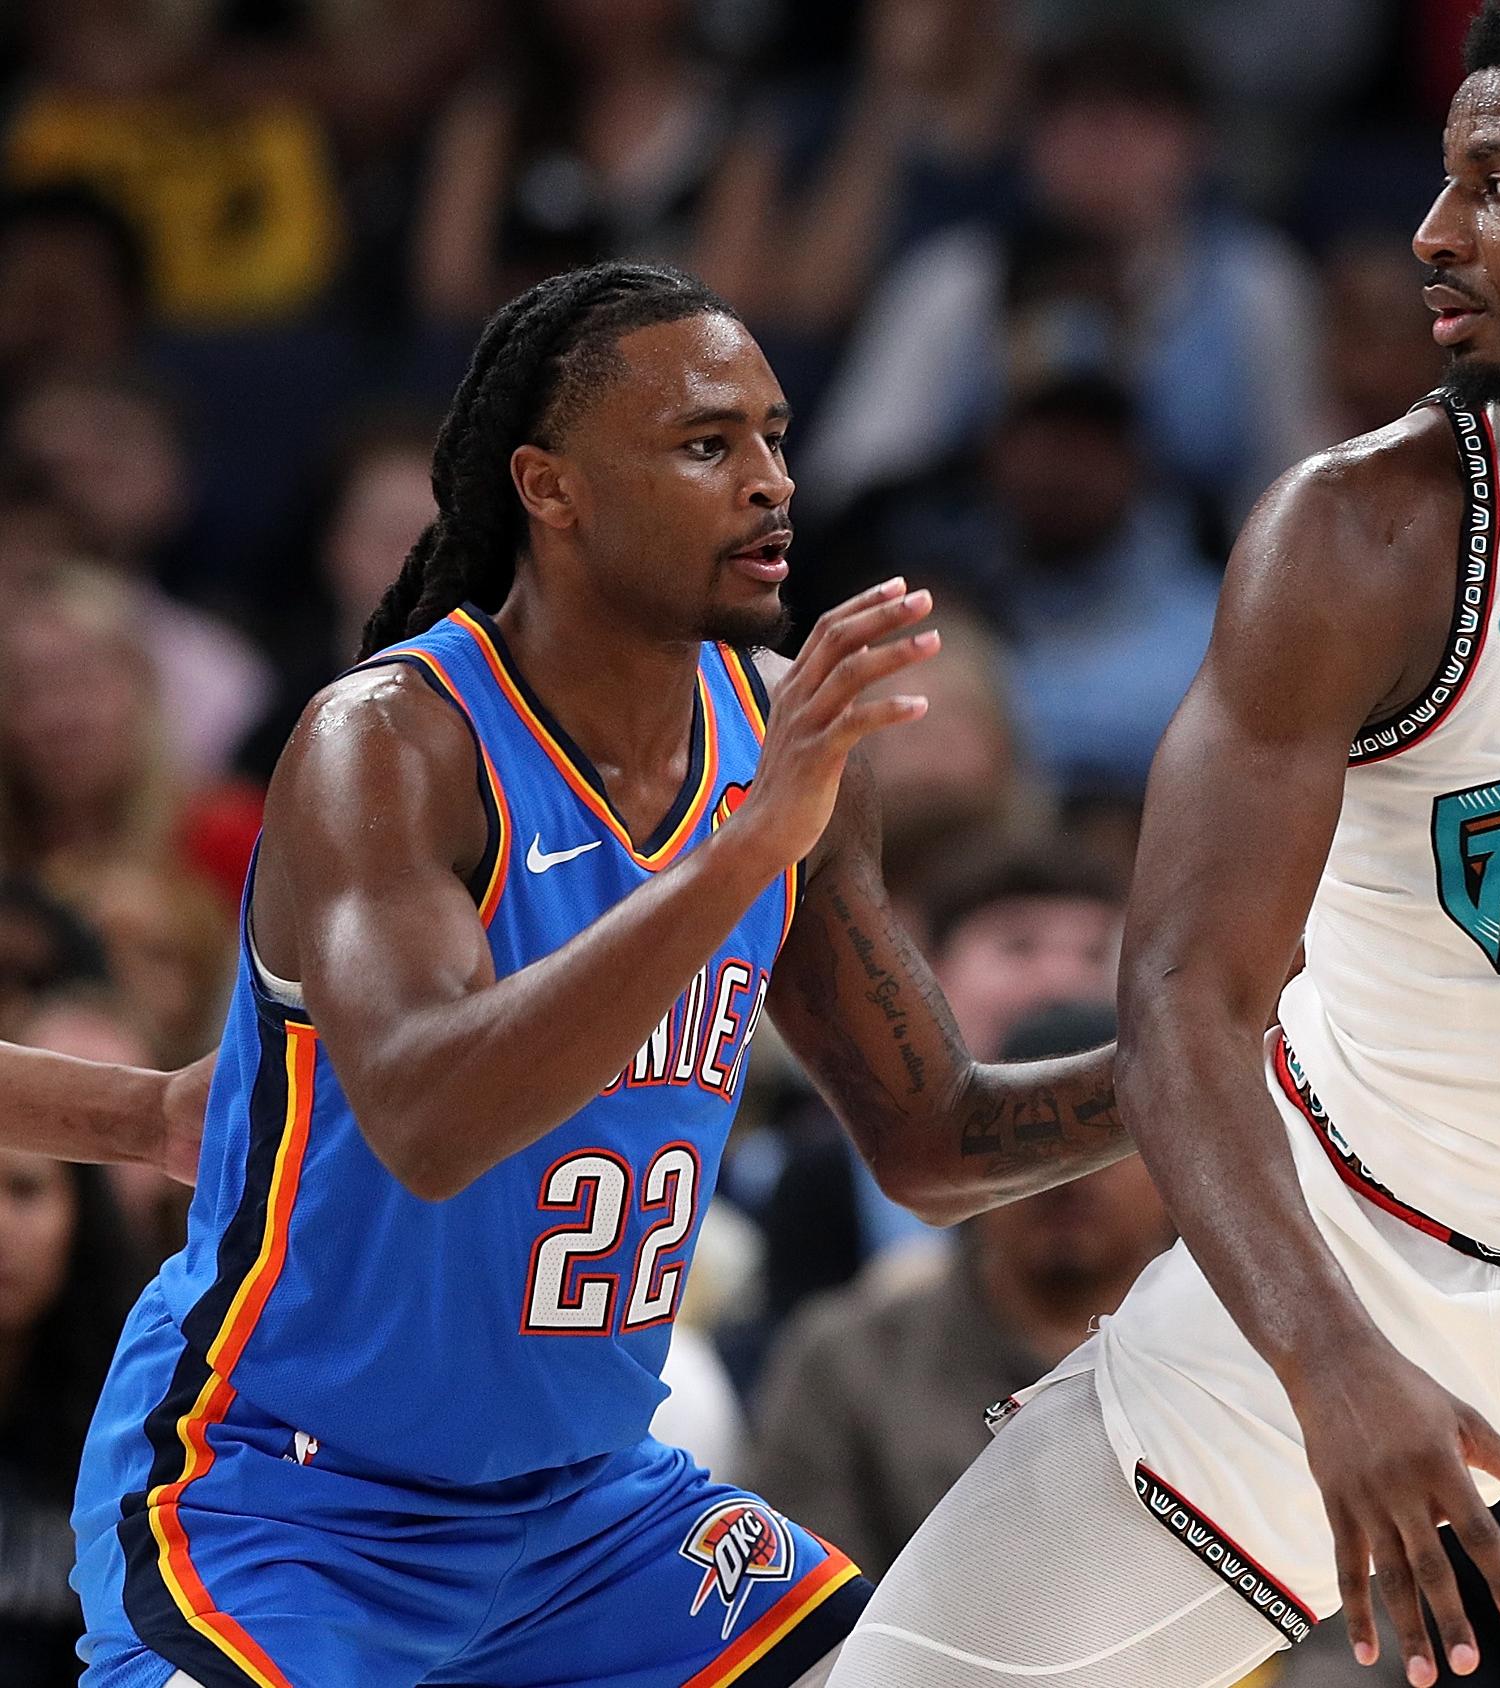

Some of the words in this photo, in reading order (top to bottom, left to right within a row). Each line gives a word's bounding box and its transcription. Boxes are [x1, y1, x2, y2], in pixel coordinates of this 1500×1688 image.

[600, 957, 768, 1103] NDER
[866, 975, 906, 1023] God
[519, 1141, 699, 1336] 22
[714, 1509, 763, 1597] OKC
